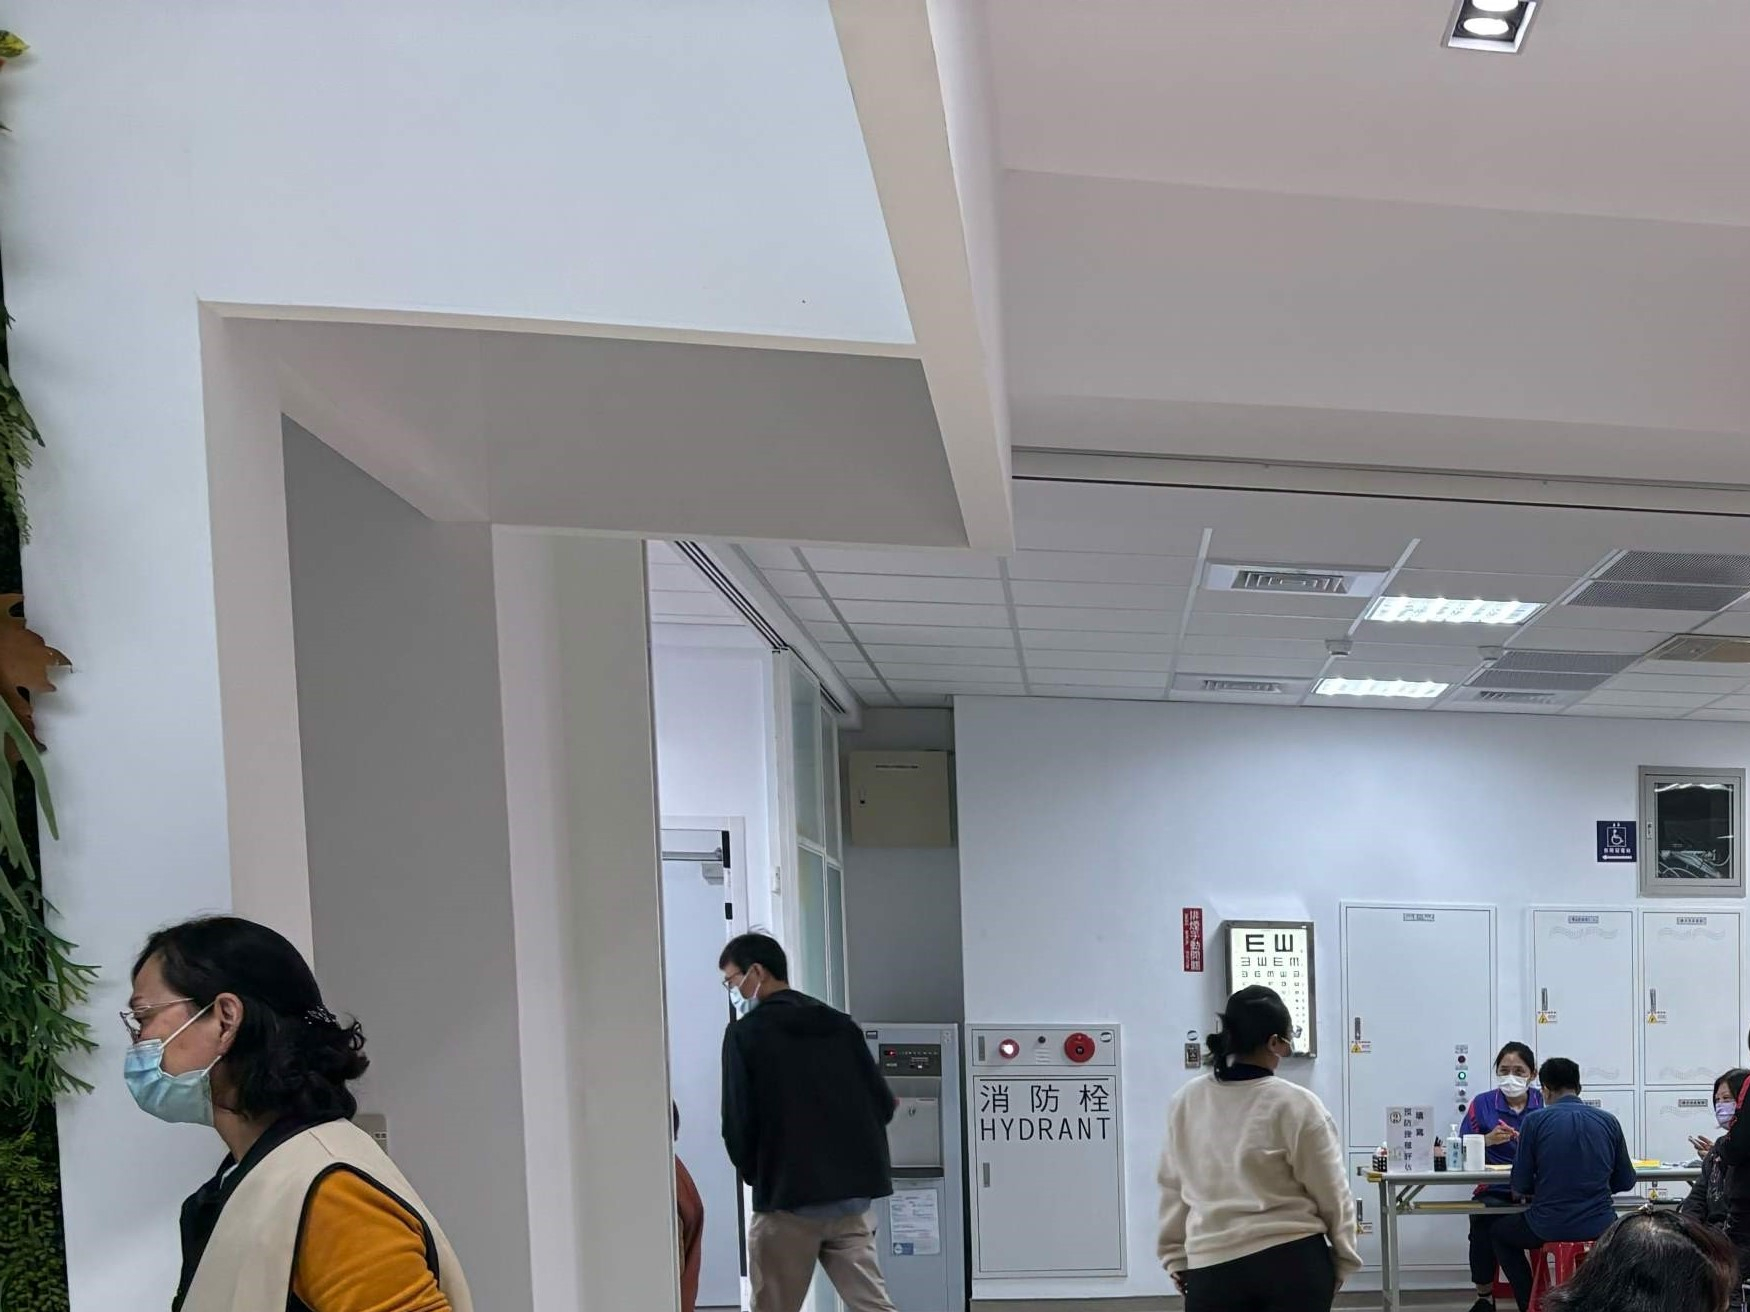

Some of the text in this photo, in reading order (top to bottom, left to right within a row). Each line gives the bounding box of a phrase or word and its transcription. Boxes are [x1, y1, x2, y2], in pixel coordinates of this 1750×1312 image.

[980, 1084, 1109, 1113] 消防栓
[980, 1117, 1111, 1141] HYDRANT
